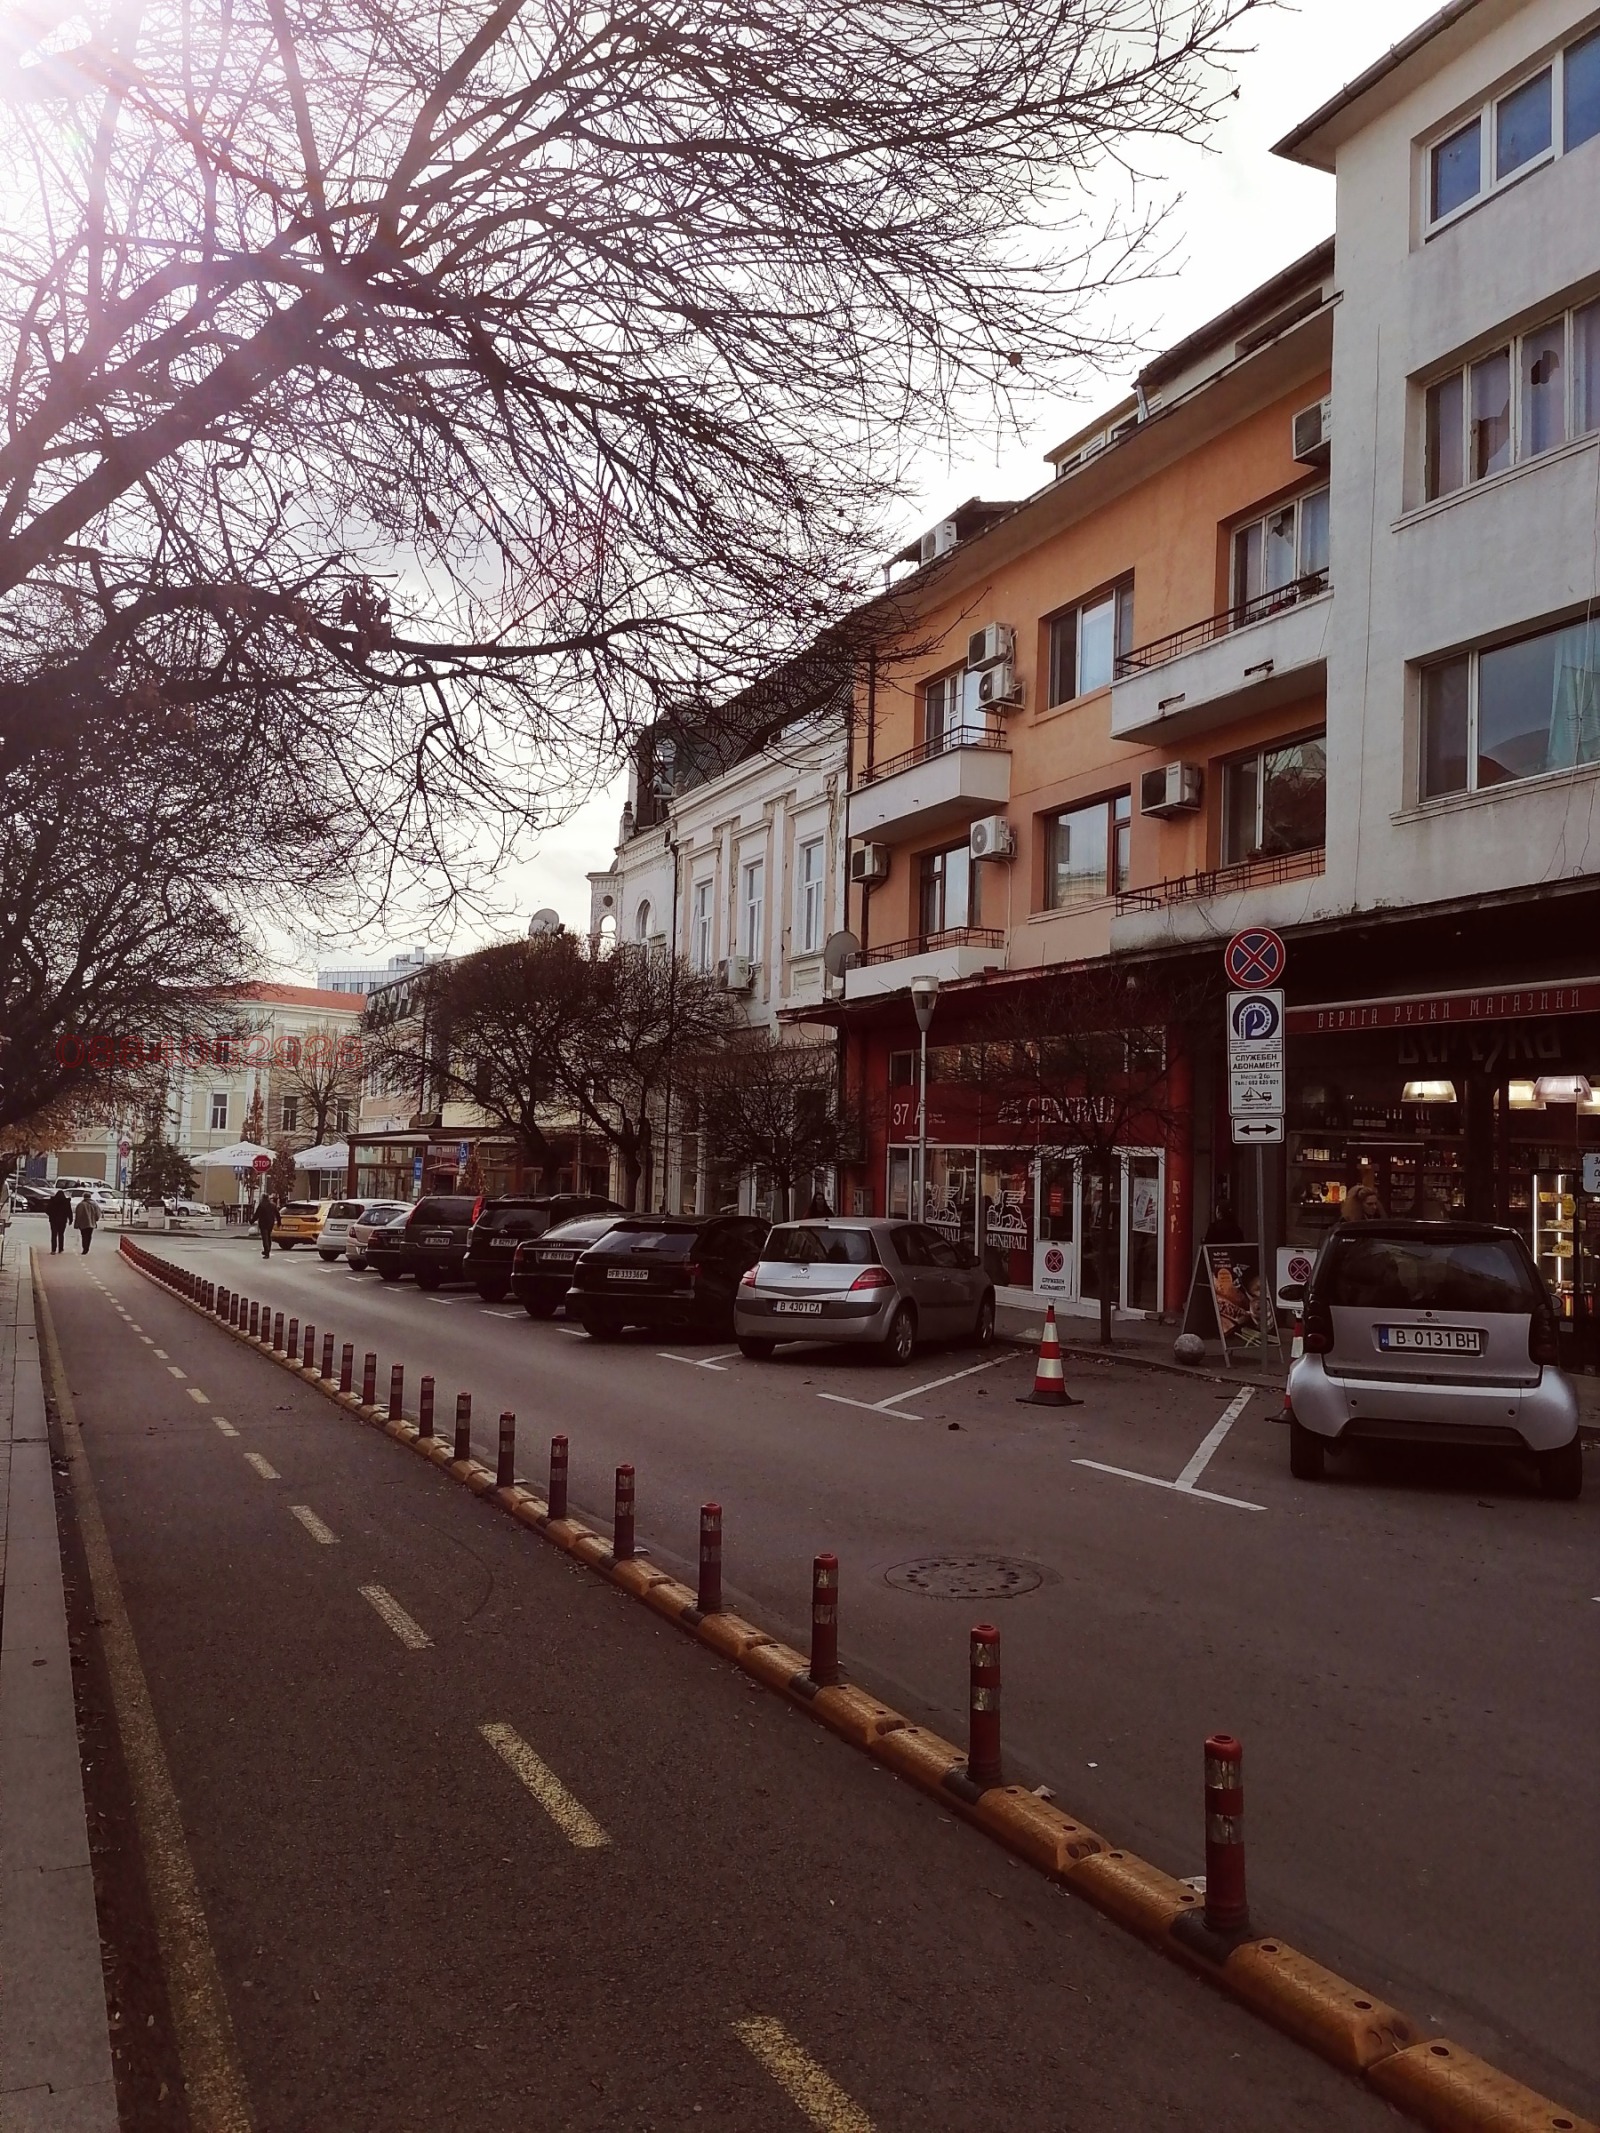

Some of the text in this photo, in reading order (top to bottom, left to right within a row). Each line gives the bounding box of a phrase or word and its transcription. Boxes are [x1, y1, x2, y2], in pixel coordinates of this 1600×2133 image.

[1318, 989, 1579, 1029] ВЕРИГА РУСКИ МАГАЗИНИ
[1235, 1053, 1277, 1062] СЛУЖЕБЕН
[1232, 1062, 1280, 1070] АБОНАМЕНТ
[893, 1103, 909, 1125] 37
[254, 1160, 270, 1168] STOP
[986, 1234, 1027, 1251] GENERALI
